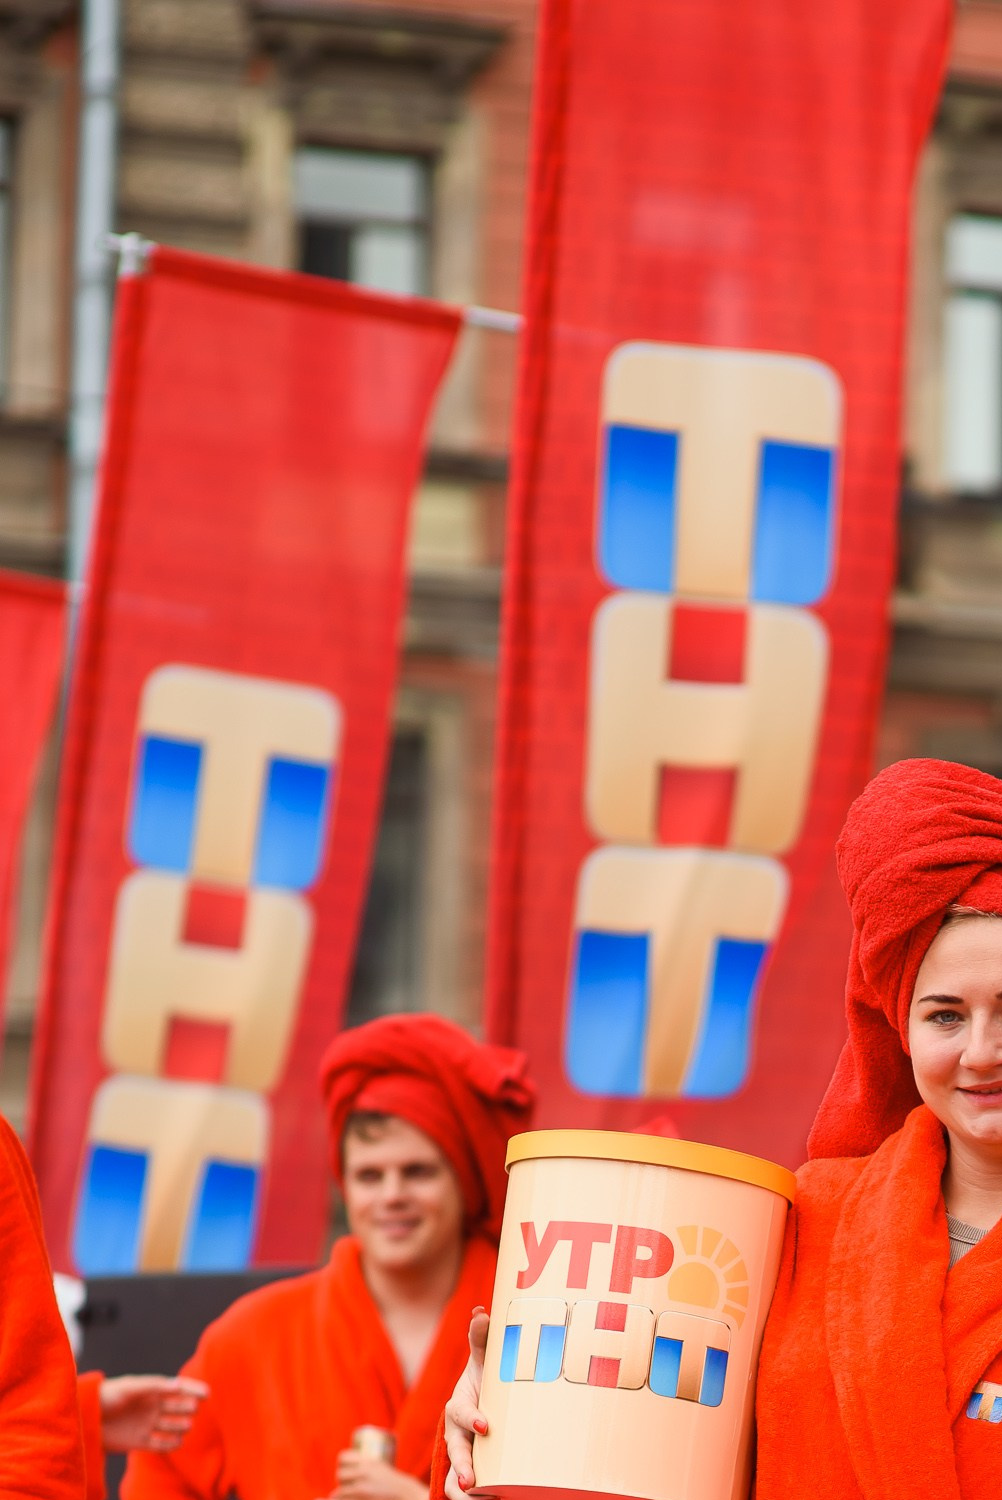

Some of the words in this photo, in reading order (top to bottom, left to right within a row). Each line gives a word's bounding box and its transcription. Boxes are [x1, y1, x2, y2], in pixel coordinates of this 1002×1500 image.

[71, 663, 342, 1273] ТНТ
[562, 340, 844, 1099] ТНТ
[499, 1297, 731, 1407] ТНТ
